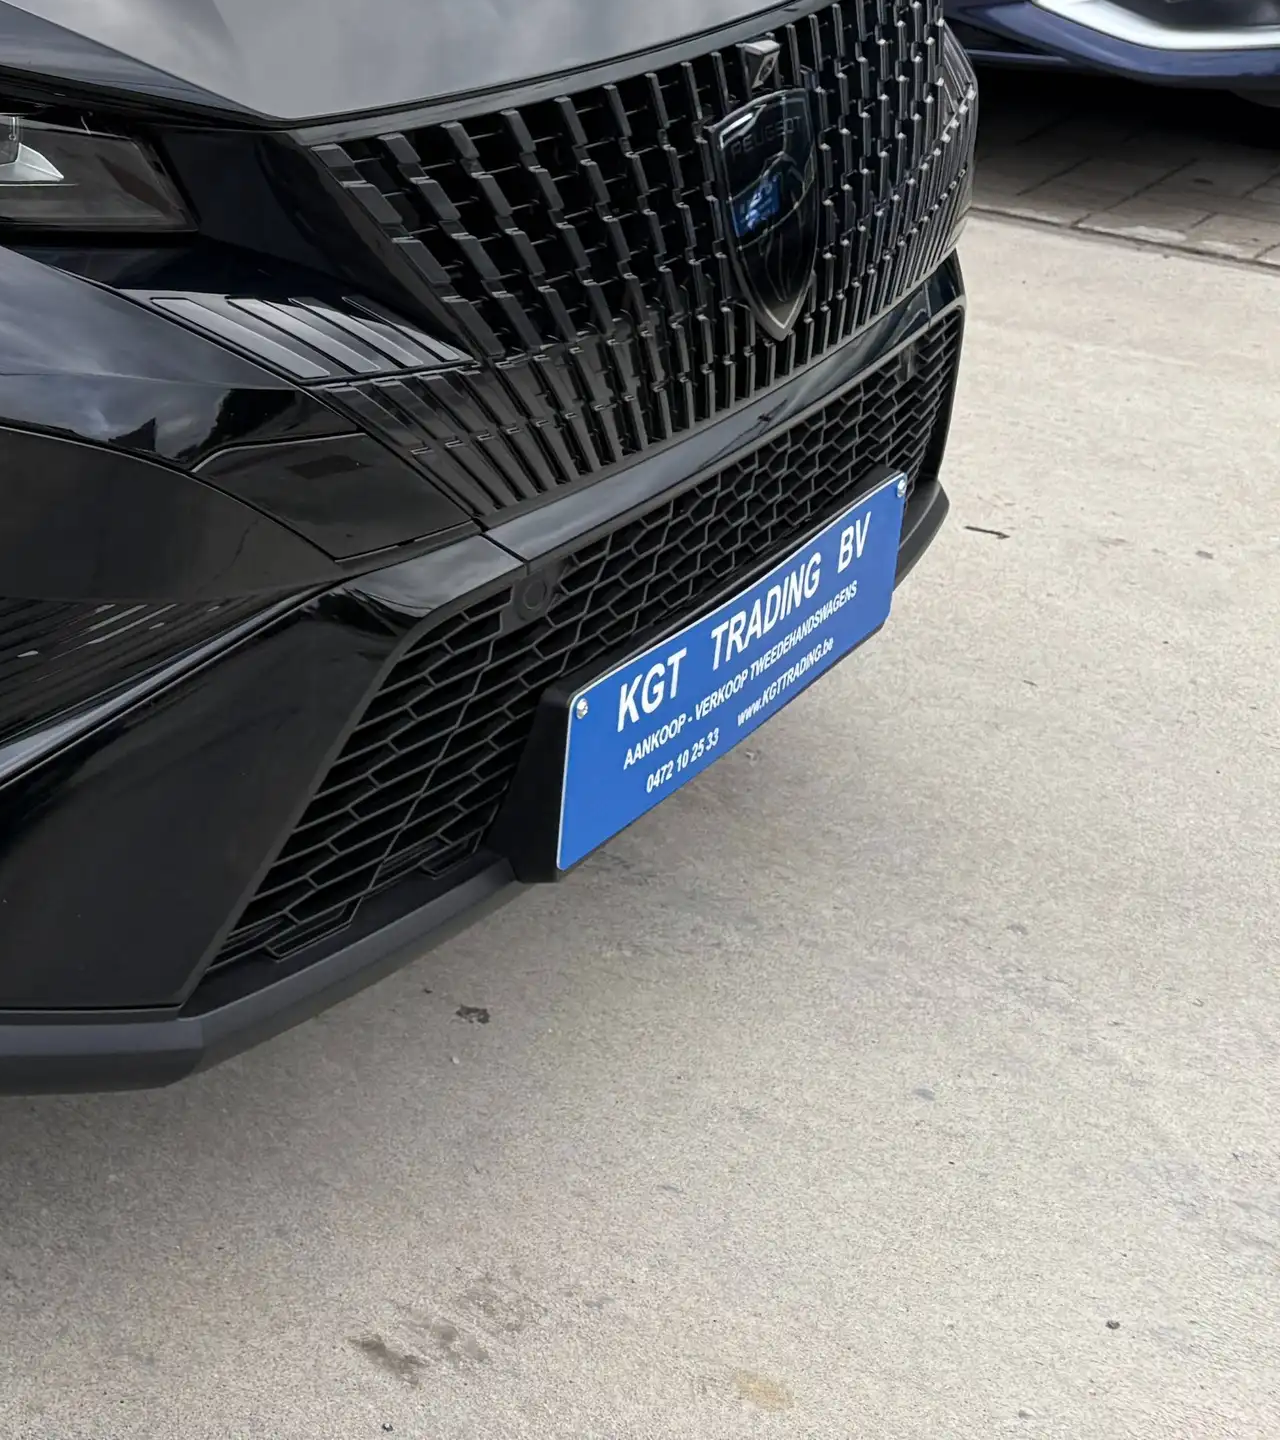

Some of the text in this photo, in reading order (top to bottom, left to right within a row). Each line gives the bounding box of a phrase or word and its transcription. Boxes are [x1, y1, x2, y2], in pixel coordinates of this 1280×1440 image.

[730, 115, 802, 160] PEUGEOT
[617, 511, 872, 732] KGT TRADING BV
[623, 713, 687, 771] AANKOOP
[695, 670, 749, 721] VERKOOP
[750, 580, 858, 681] TWEEDEHANDSWAGENS
[646, 637, 834, 793] 0472 10 25 33 www.KGTTRADING.be
